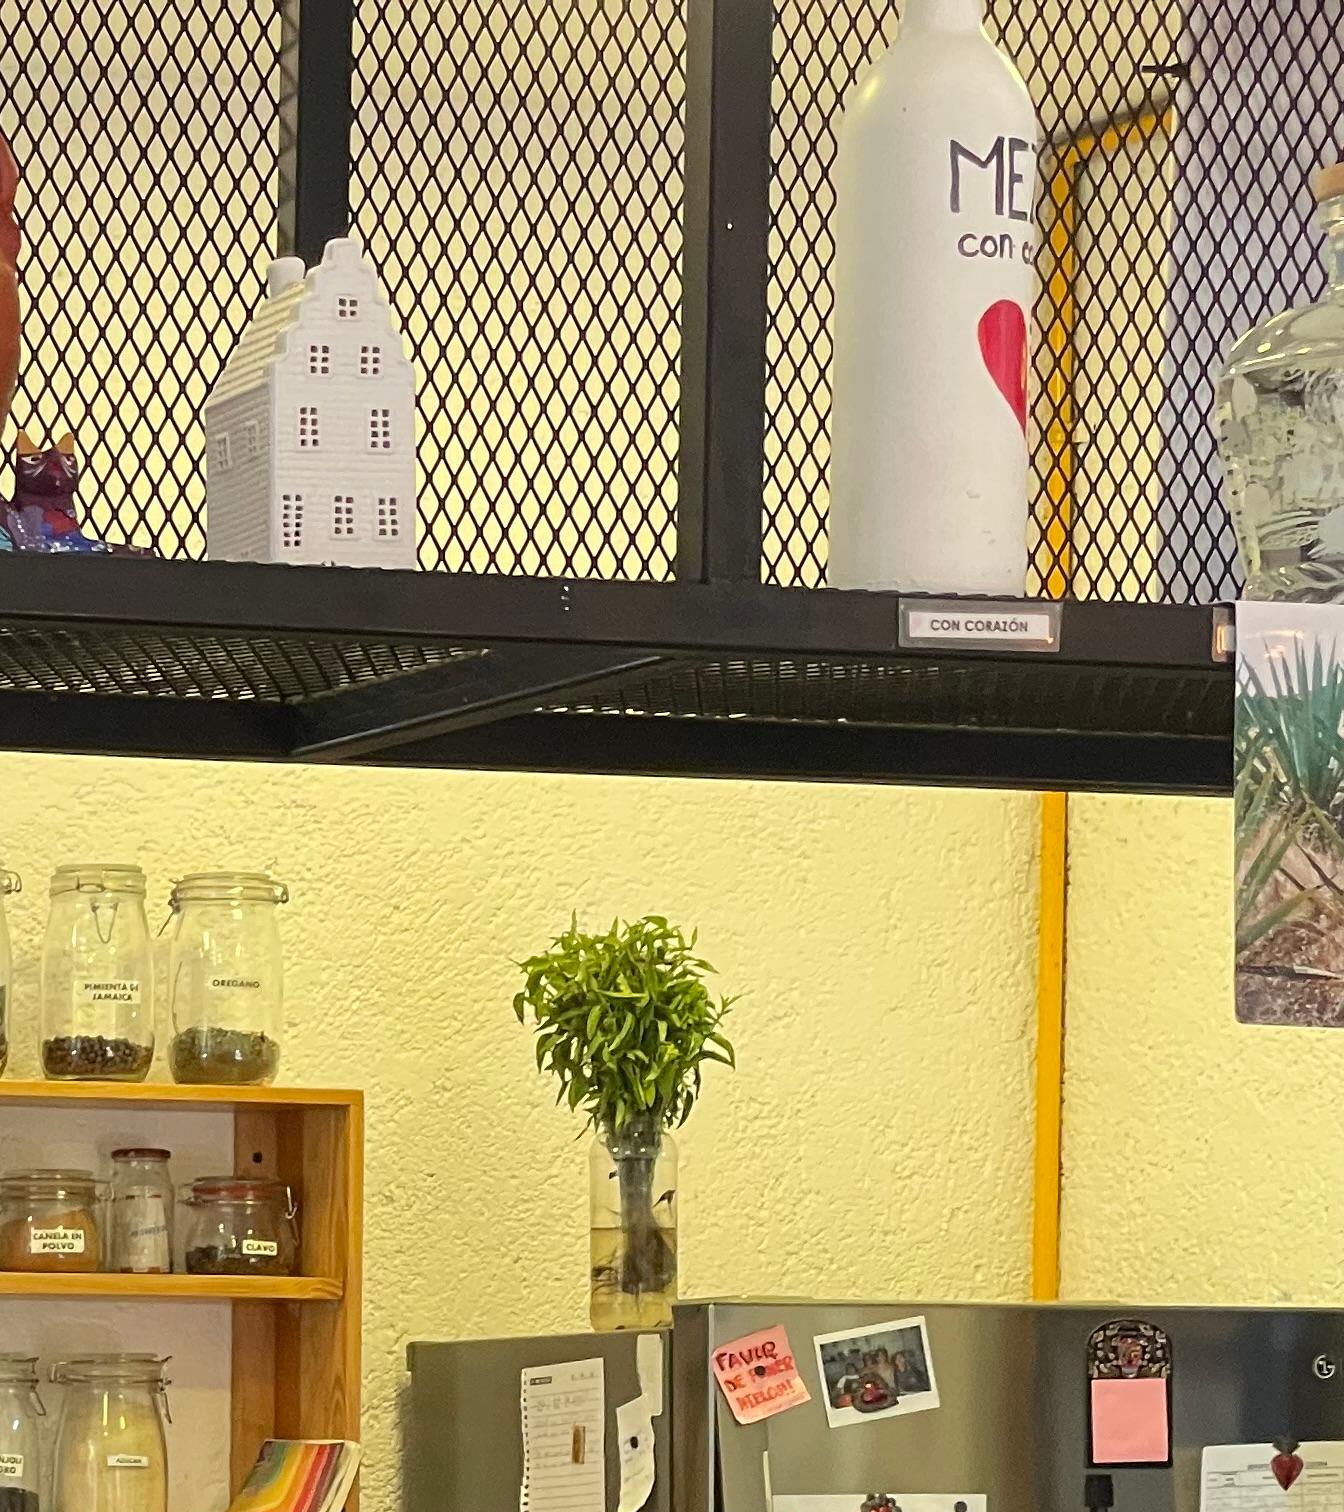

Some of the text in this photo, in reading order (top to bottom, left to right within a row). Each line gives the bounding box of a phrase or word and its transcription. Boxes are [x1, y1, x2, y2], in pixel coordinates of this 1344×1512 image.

[950, 136, 1036, 224] ME
[958, 233, 1013, 258] con
[930, 617, 1028, 632] CON CORAZÓN
[93, 993, 133, 1001] JAMAICA
[33, 1232, 69, 1240] CANELA
[42, 1242, 75, 1250] POLVO
[246, 1243, 275, 1252] CLAVO
